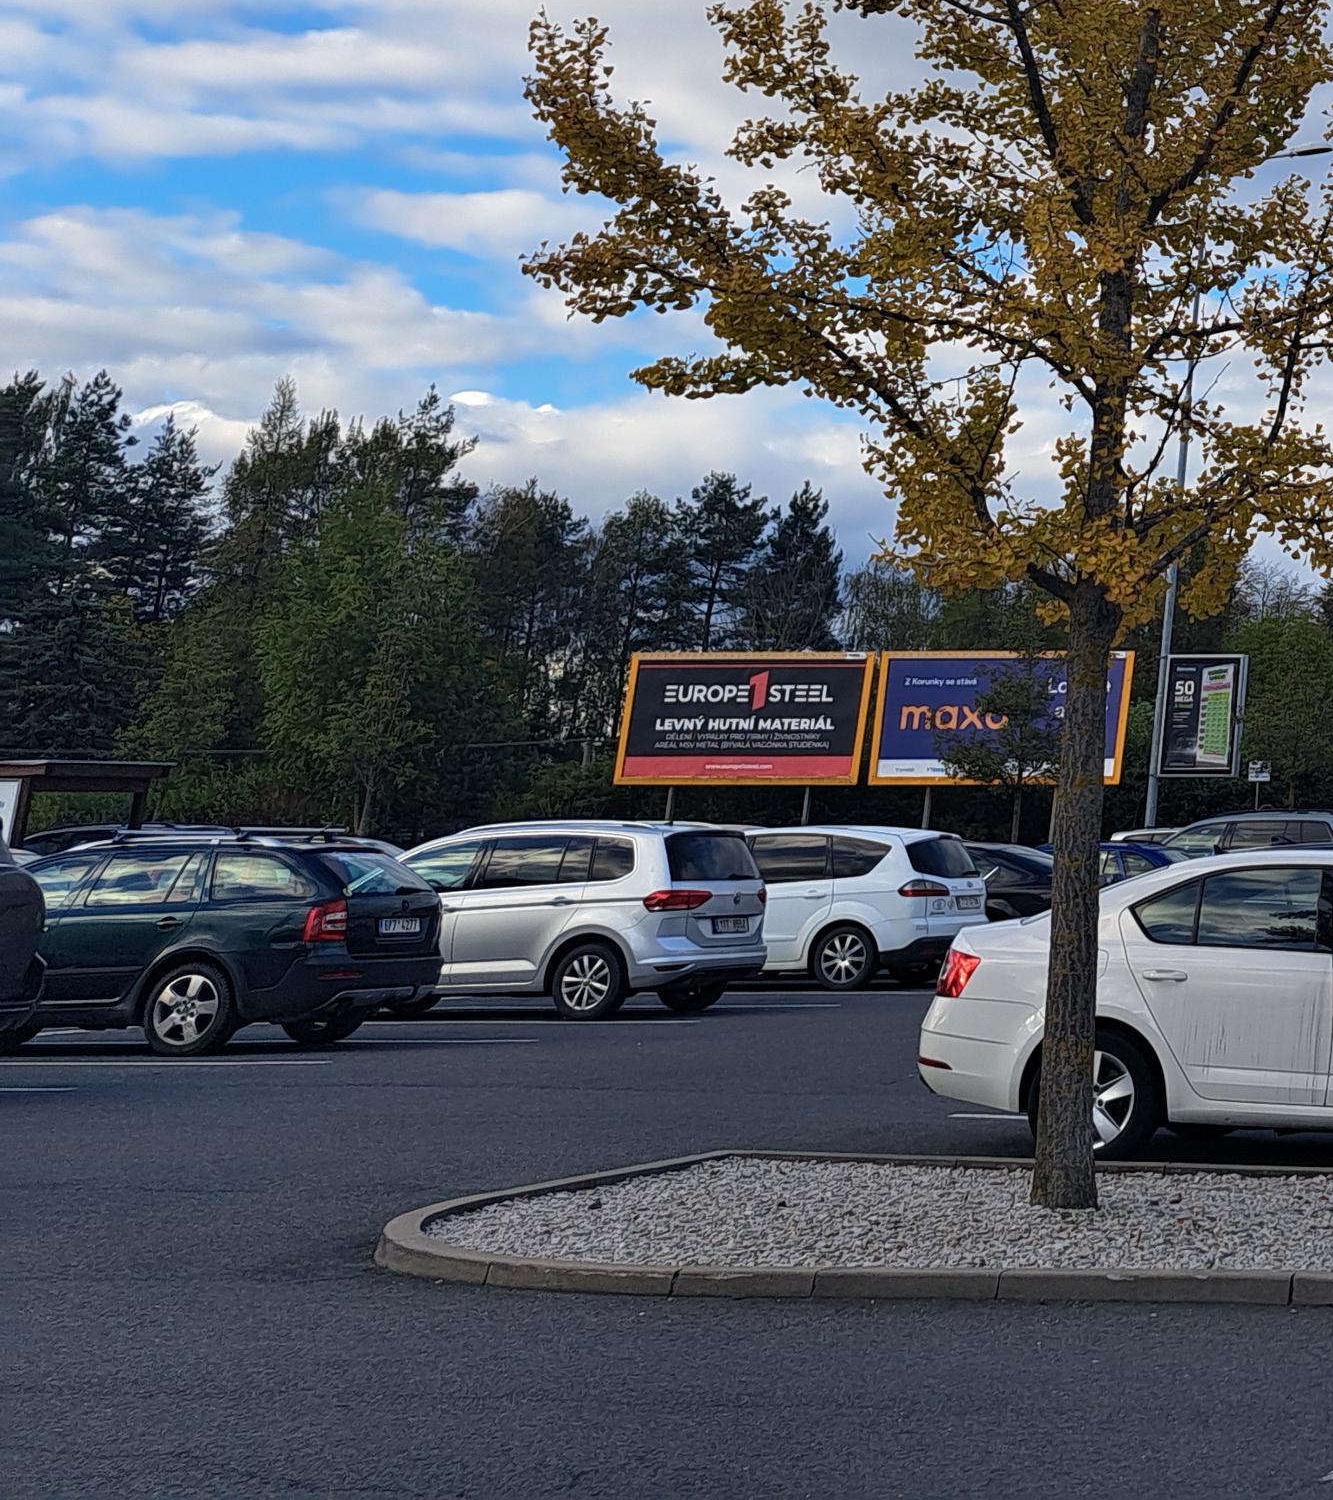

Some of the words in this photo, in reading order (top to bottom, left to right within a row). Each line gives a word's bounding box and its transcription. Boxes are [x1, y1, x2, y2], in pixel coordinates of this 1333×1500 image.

[912, 678, 944, 687] Korunky
[1175, 680, 1194, 695] 50
[655, 715, 705, 731] LEVNÝ
[708, 715, 756, 731] HUTNÍ
[758, 714, 835, 730] MATERIÁL
